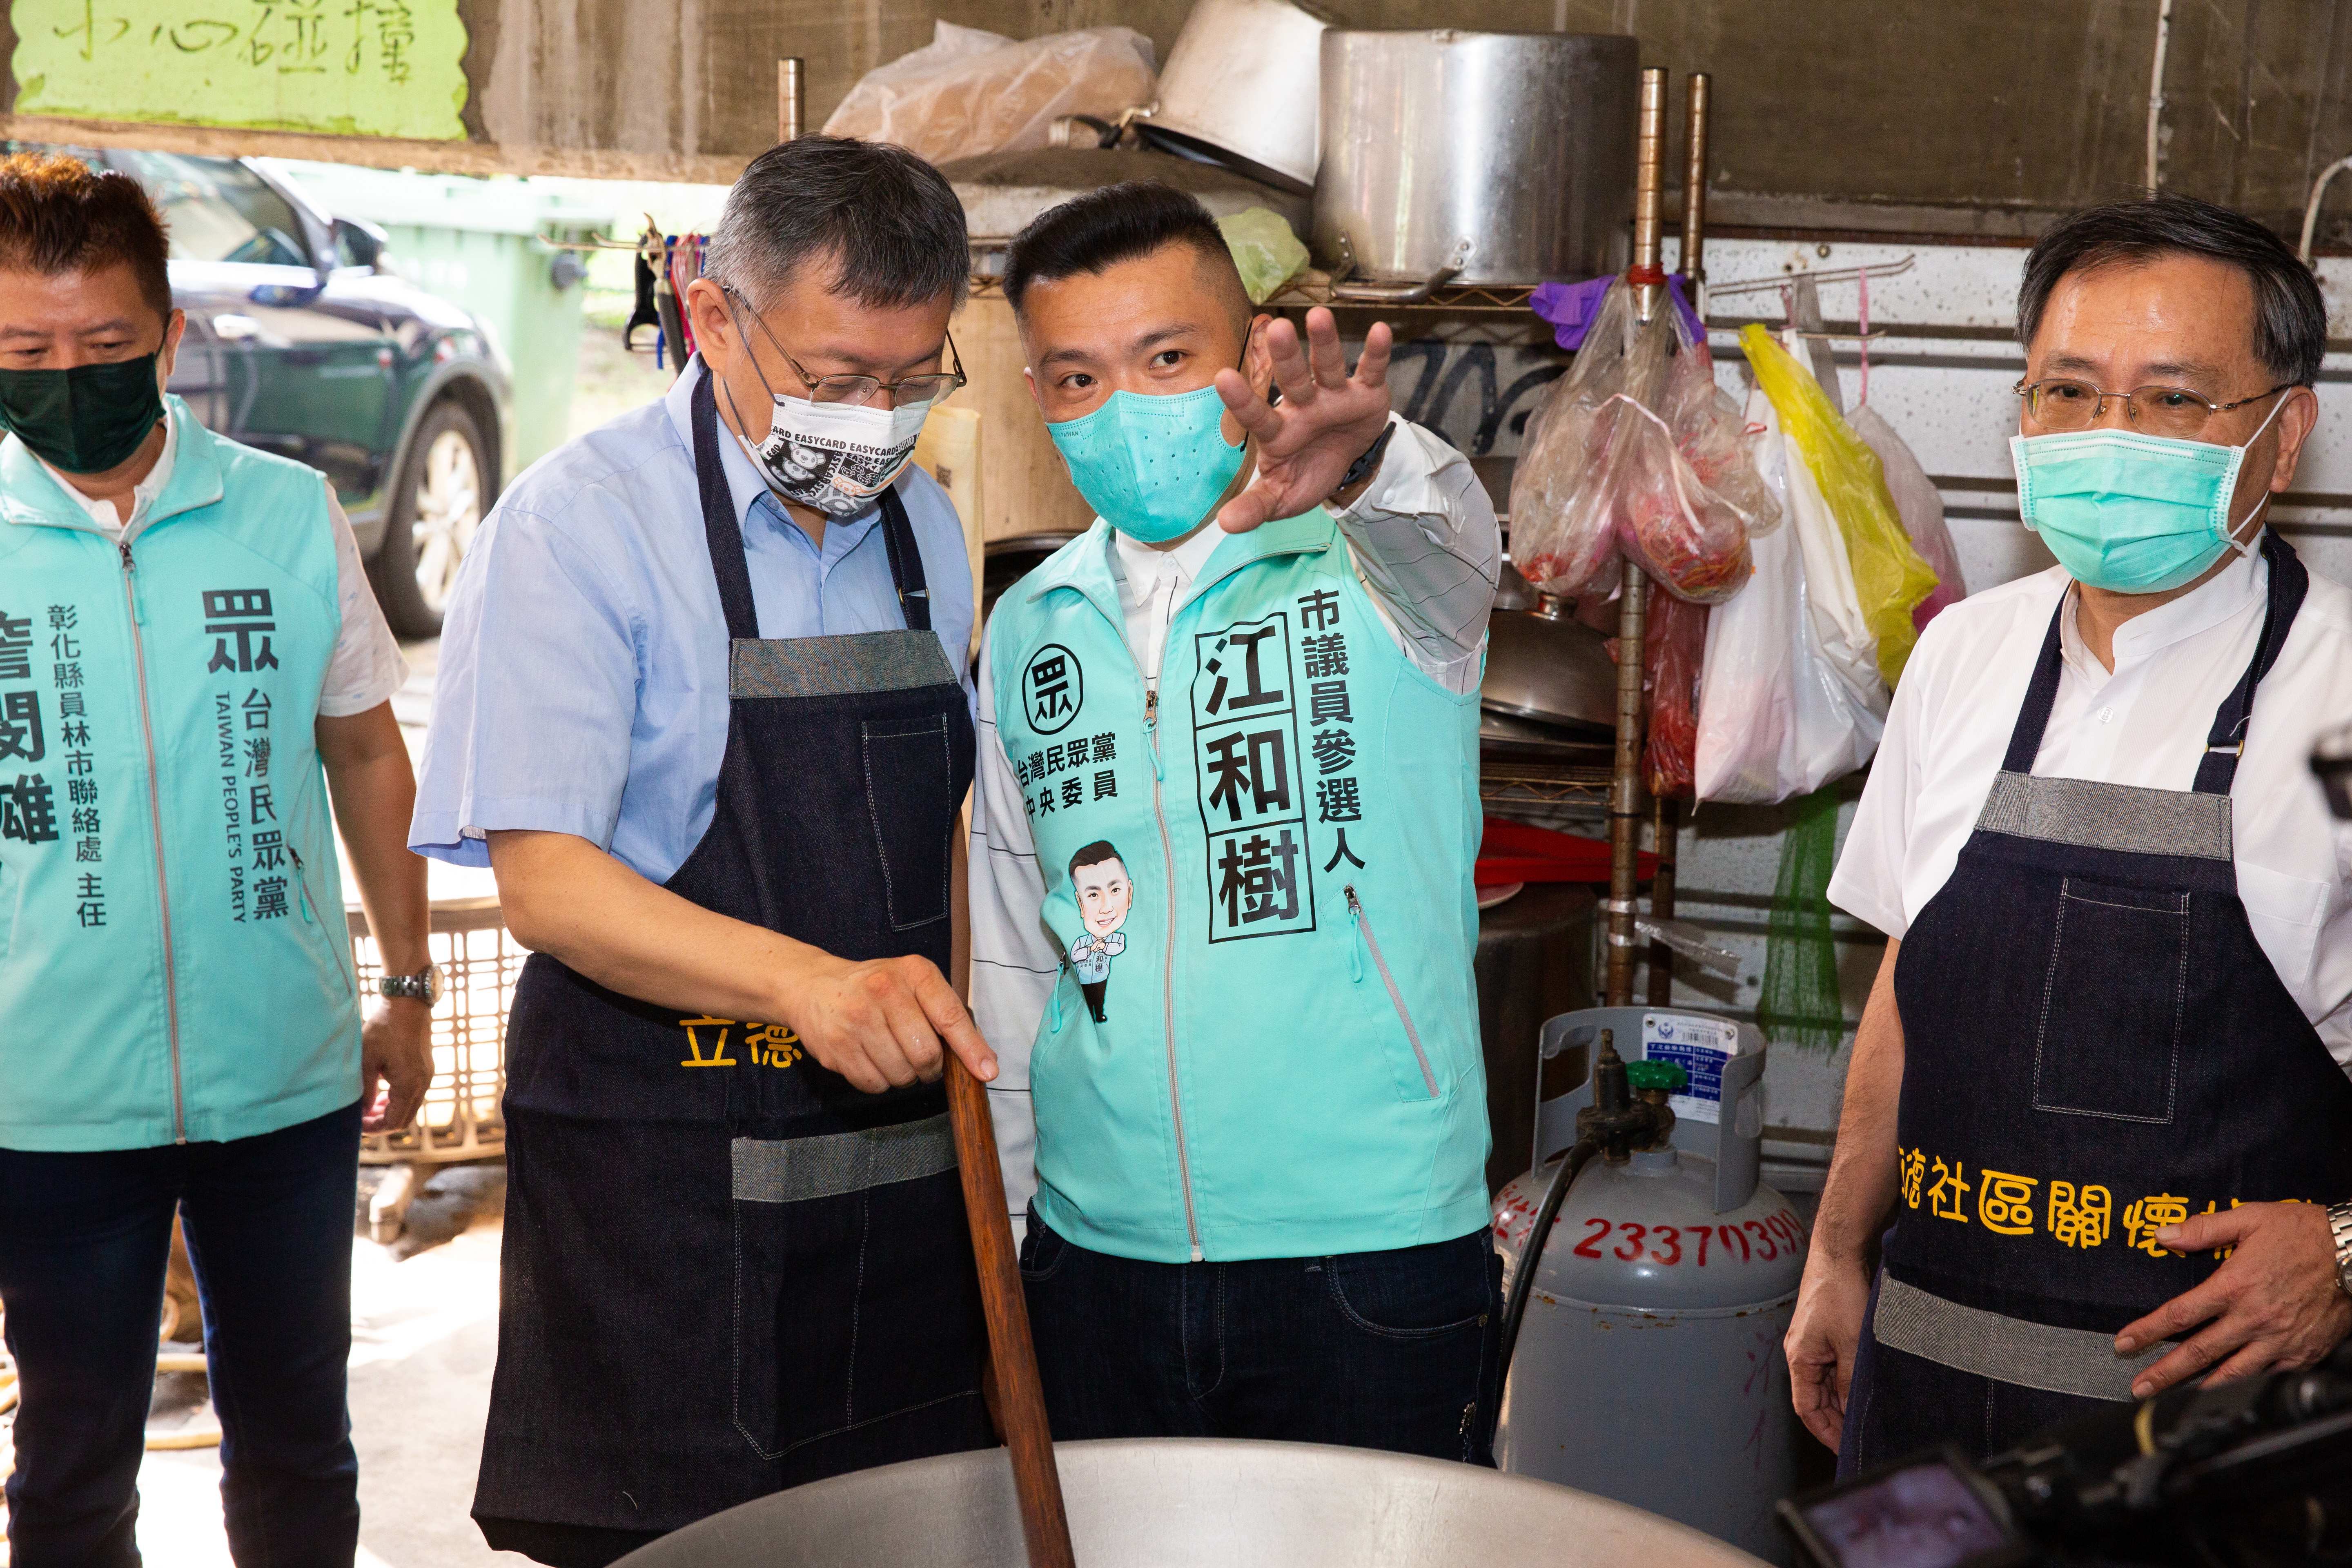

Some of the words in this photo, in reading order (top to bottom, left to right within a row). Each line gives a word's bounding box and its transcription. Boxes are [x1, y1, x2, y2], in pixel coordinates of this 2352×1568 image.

[52, 0, 416, 83] 小心碰撞
[794, 433, 846, 450] EASYCARD
[849, 443, 895, 457] EASYCARD
[202, 588, 279, 674] 眾
[1031, 653, 1074, 721] 眾
[216, 690, 235, 767] TAIWAN
[1018, 731, 1117, 789] 台灣民眾黨
[1297, 588, 1366, 873] 市議員參選人
[241, 687, 289, 920] 台灣民眾黨
[1025, 769, 1118, 824] 中央委員
[1204, 623, 1301, 928] 江和樹
[222, 775, 242, 859] PEOPLE'S
[230, 866, 246, 923] PARTY
[1094, 951, 1104, 973] 和樹
[1899, 1145, 2312, 1260] 德社區關懷
